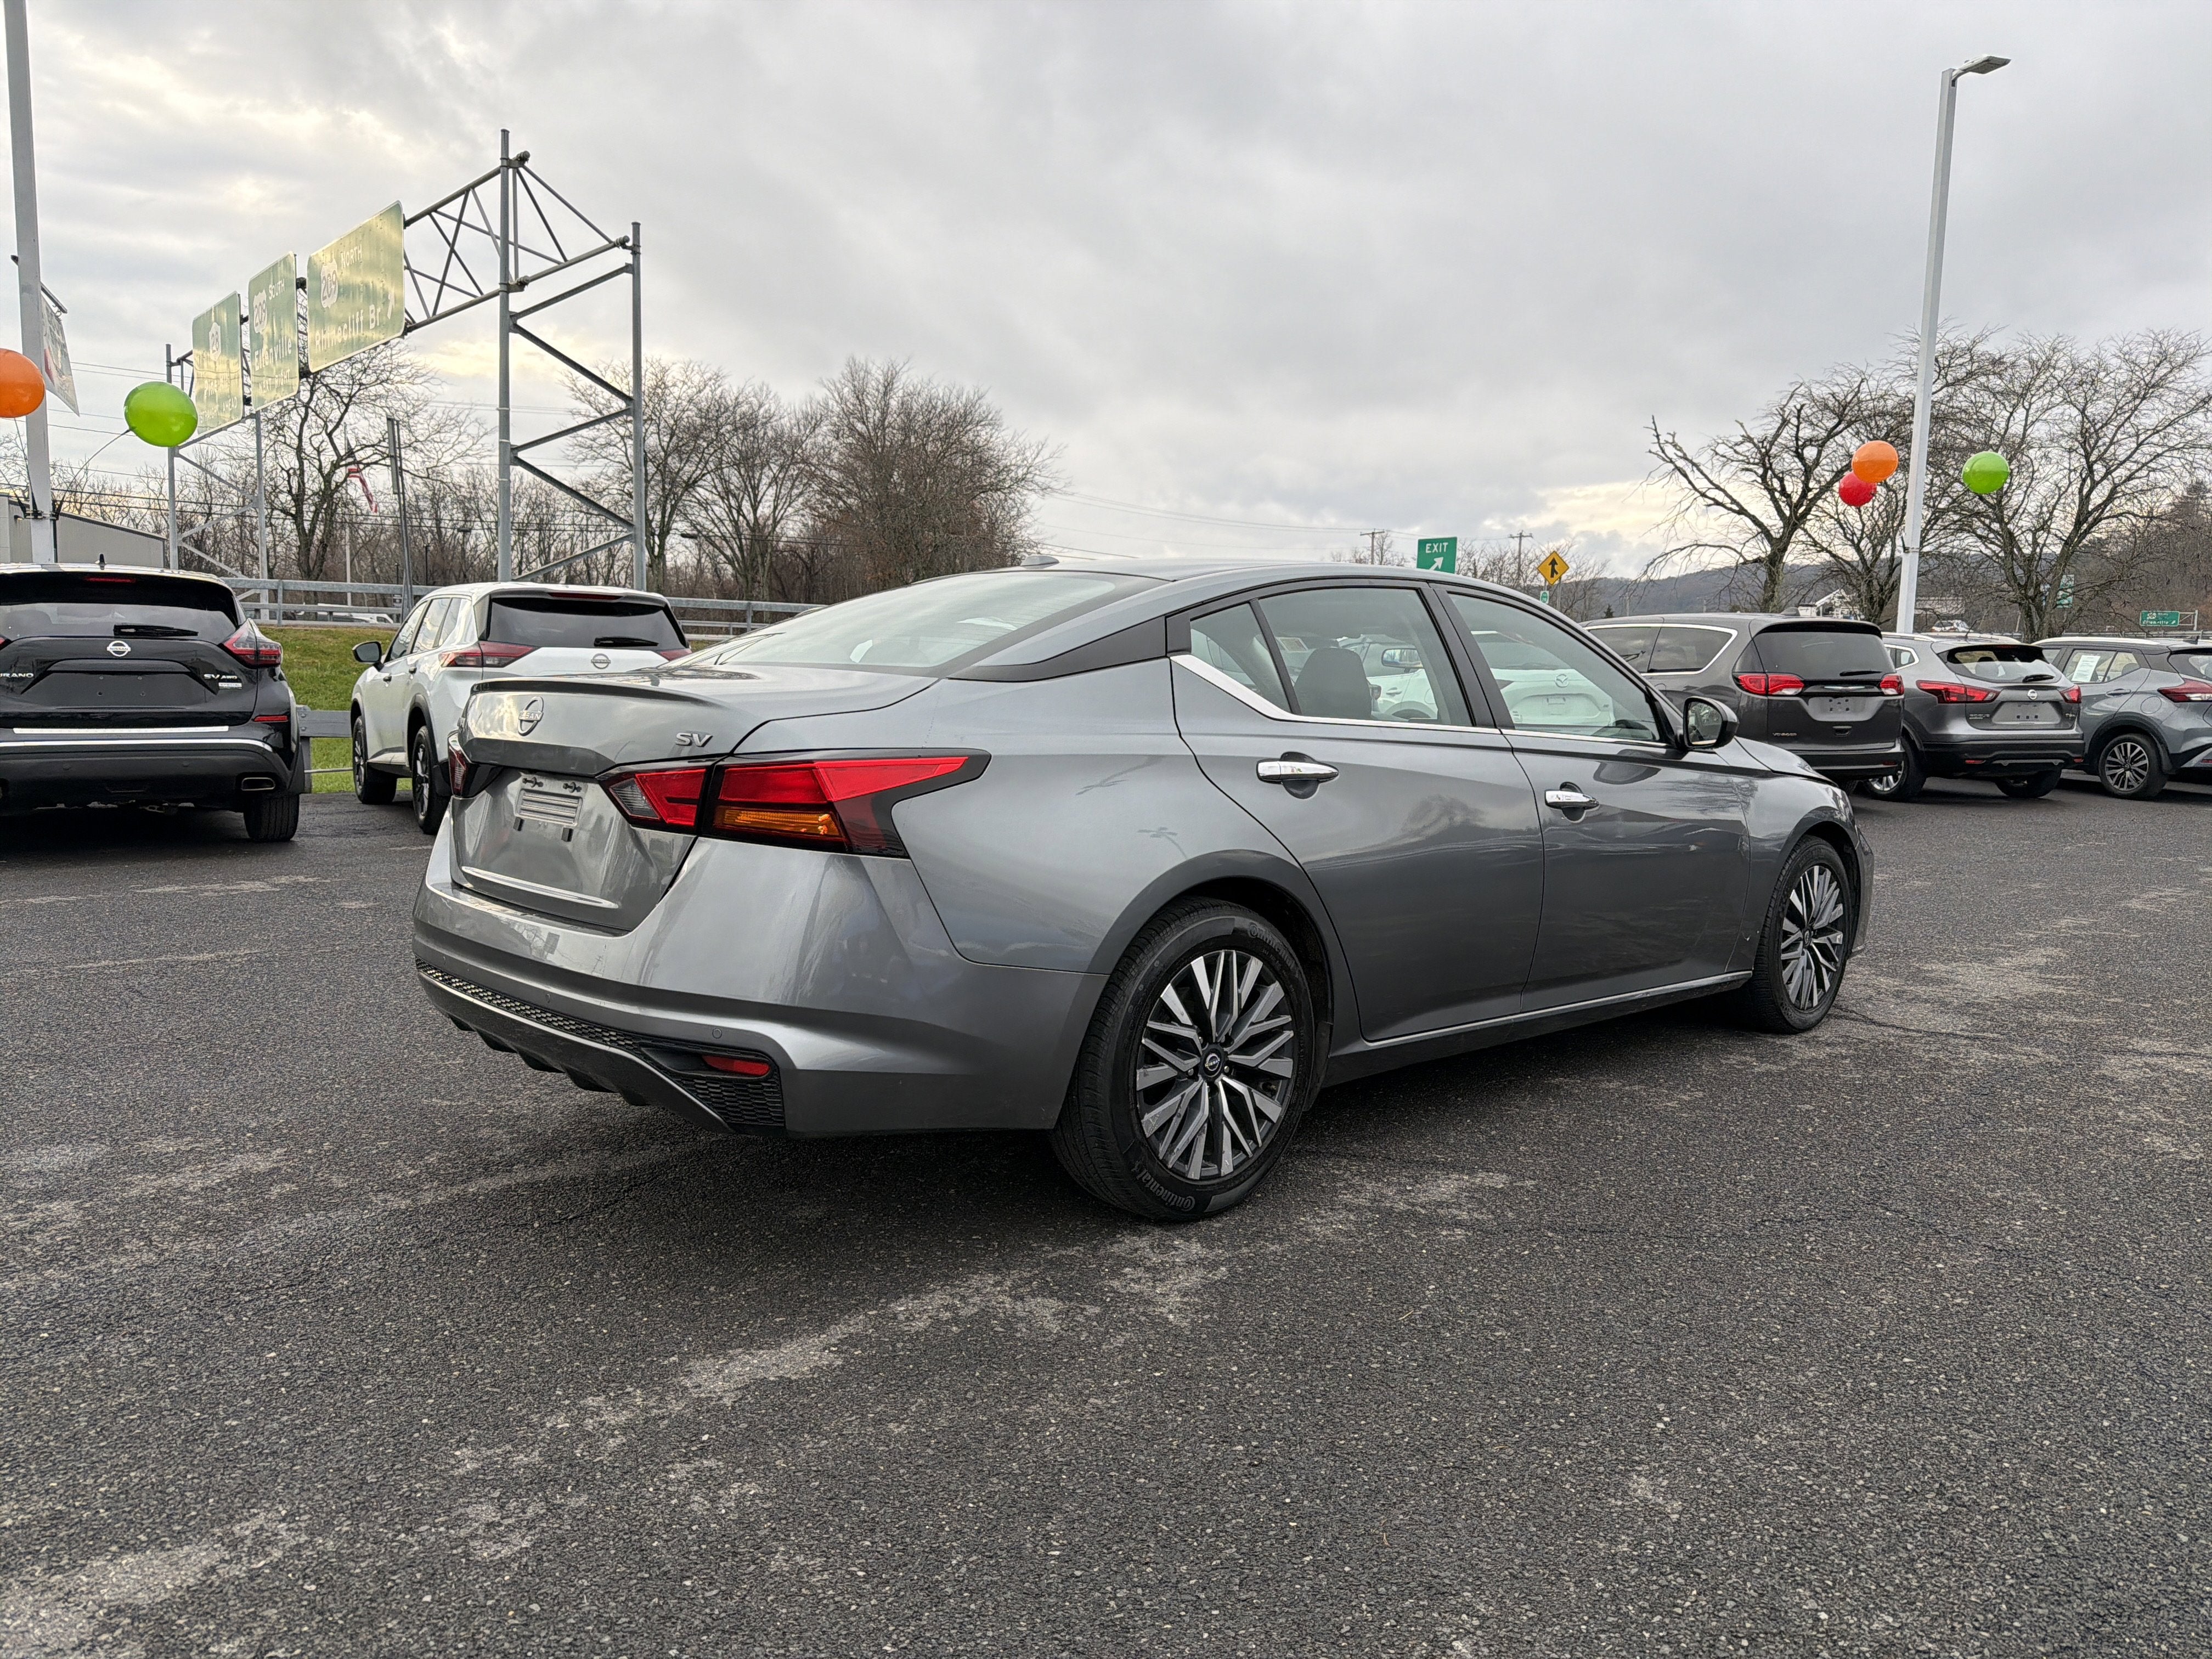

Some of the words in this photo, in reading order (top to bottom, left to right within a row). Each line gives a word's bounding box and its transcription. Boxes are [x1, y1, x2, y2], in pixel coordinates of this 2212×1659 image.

[341, 244, 362, 269] NORTH
[268, 279, 285, 301] SOUTH
[321, 269, 337, 302] 209
[254, 302, 266, 327] 209
[315, 309, 364, 352] Rhinecliff
[369, 304, 381, 330] Br
[211, 331, 219, 353] 28
[255, 336, 292, 371] Ellenville
[259, 378, 272, 394] NEXT
[275, 369, 290, 388] RIGHT
[222, 396, 238, 414] AHEAD
[1425, 542, 1448, 554] EXIT
[675, 732, 713, 747] SV
[1136, 1168, 1195, 1212] Continental
